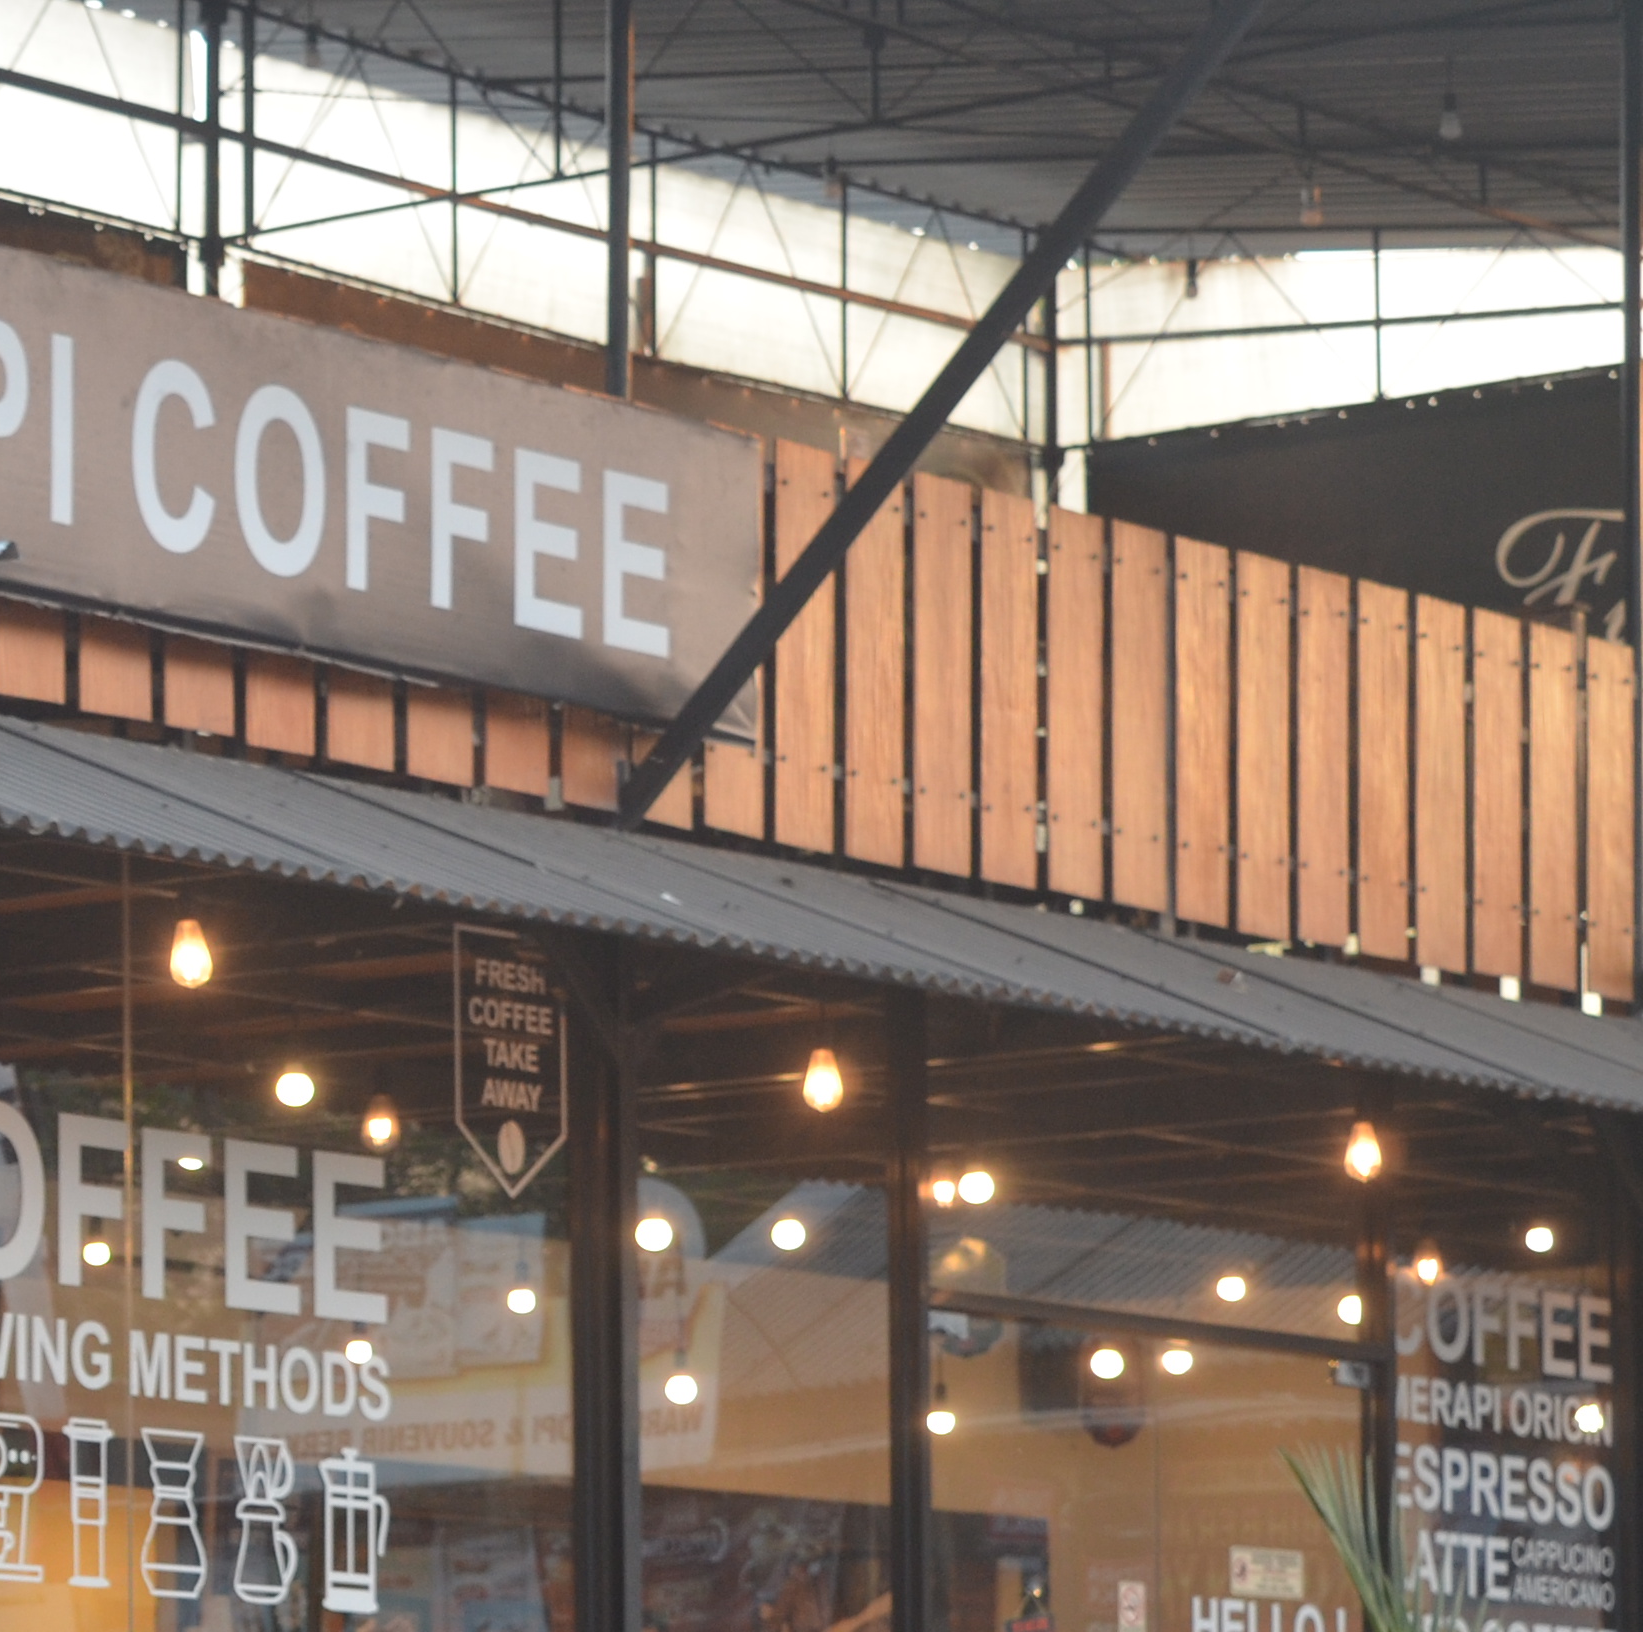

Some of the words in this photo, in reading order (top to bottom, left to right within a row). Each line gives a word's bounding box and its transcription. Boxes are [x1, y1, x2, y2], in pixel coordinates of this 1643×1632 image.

[132, 358, 671, 660] COFFEE
[475, 956, 546, 996] FRESH
[468, 997, 554, 1037] COFFEE
[482, 1037, 541, 1075] TAKE
[481, 1077, 543, 1114] AWAY
[129, 1329, 392, 1423] METHODS
[1396, 1441, 1614, 1533] ESPRESSO
[1403, 1529, 1510, 1603] ATTE
